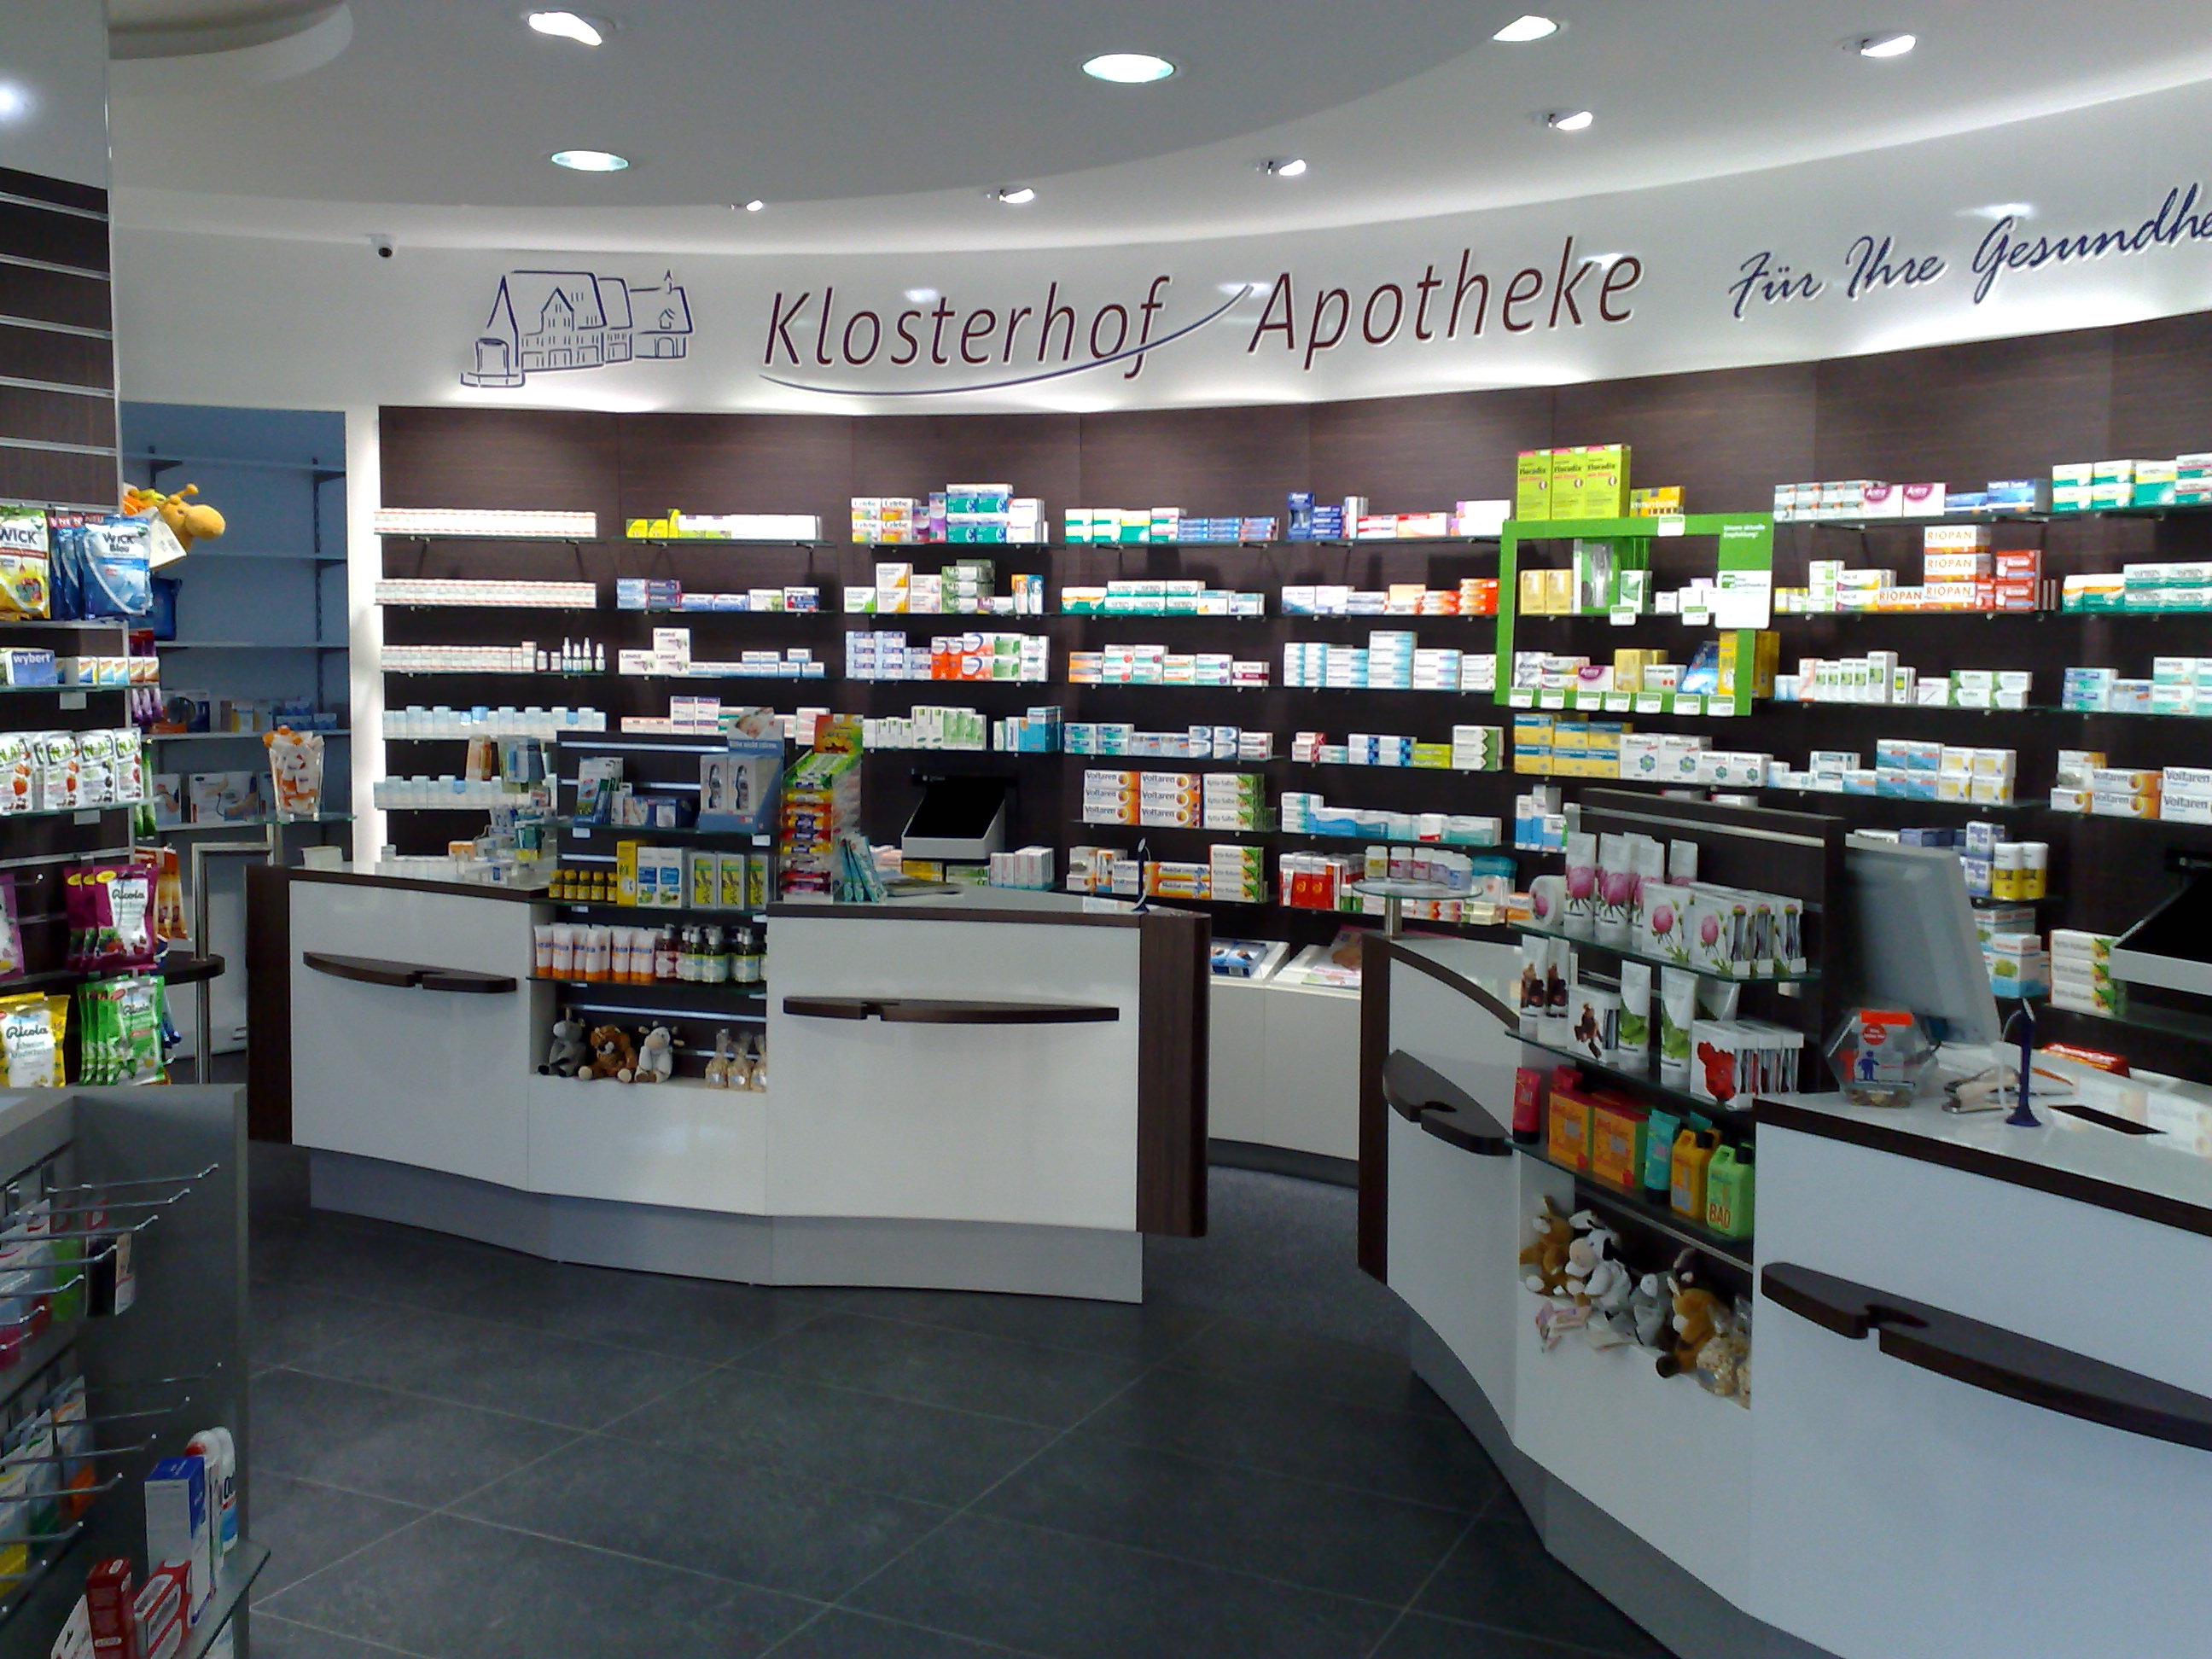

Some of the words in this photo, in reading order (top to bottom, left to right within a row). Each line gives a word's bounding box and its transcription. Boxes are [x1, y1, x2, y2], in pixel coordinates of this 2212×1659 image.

[1729, 252, 1824, 319] Für
[1846, 236, 1945, 299] Ihre
[764, 275, 1171, 380] Klosterhof
[1247, 236, 1642, 370] Apotheke
[0, 527, 38, 544] WICK
[102, 533, 134, 544] WICK
[1927, 530, 1973, 541] RIOPAN
[1926, 558, 1972, 569] RIOPAN
[1879, 591, 1922, 601] RIOPAN
[1926, 585, 1971, 597] RIOPAN
[13, 653, 51, 666] wybert
[1086, 771, 1117, 781] Voltaren
[1142, 774, 1175, 783] Voltaren
[2093, 771, 2128, 782] Voltaren
[2165, 769, 2210, 783] Voltaren
[1086, 789, 1116, 798] Voltaren
[1142, 791, 1175, 800] Voltaren
[2093, 793, 2130, 804] Voltaren
[2163, 795, 2209, 809] Voltaren
[1085, 806, 1115, 814] Voltaren
[1142, 809, 1175, 818] Voltaren
[112, 888, 145, 900] Ricola
[6, 1024, 49, 1039] Ricola
[1708, 1203, 1731, 1229] BAD
